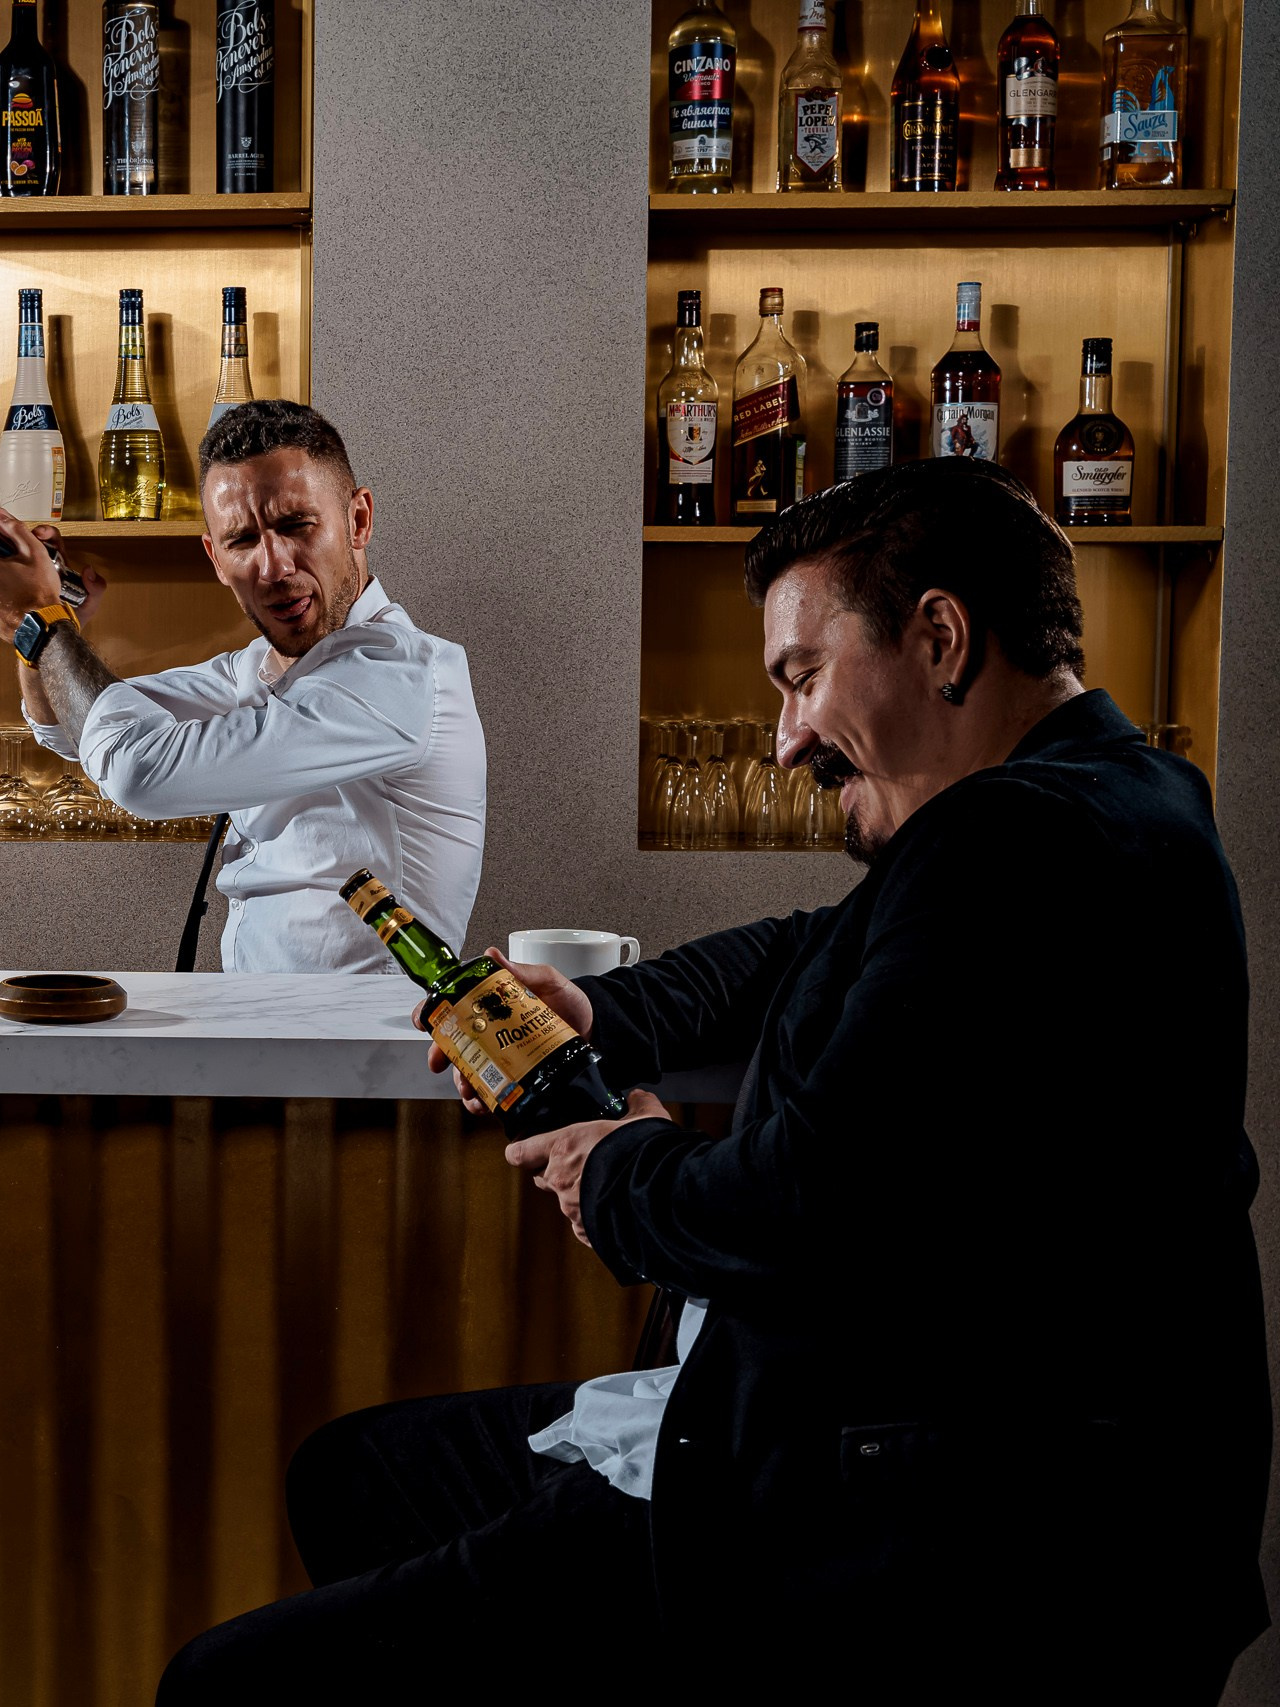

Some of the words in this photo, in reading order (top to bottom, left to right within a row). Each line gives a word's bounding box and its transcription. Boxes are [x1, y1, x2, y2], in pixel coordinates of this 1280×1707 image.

[105, 8, 155, 62] Bols
[219, 0, 266, 50] Bols
[674, 56, 731, 74] CINZANO
[2, 108, 43, 127] PASSOÃ
[802, 104, 833, 116] PEPE
[799, 116, 836, 127] LOPEZ
[1124, 112, 1168, 140] Sauza
[12, 404, 43, 430] Bols
[111, 404, 141, 430] Bols
[733, 410, 752, 422] RED
[753, 397, 786, 414] LABEL
[964, 406, 995, 421] Morgan
[835, 427, 890, 437] GLENLASSIE
[1071, 465, 1127, 486] Smuggler
[541, 1022, 557, 1036] 1885
